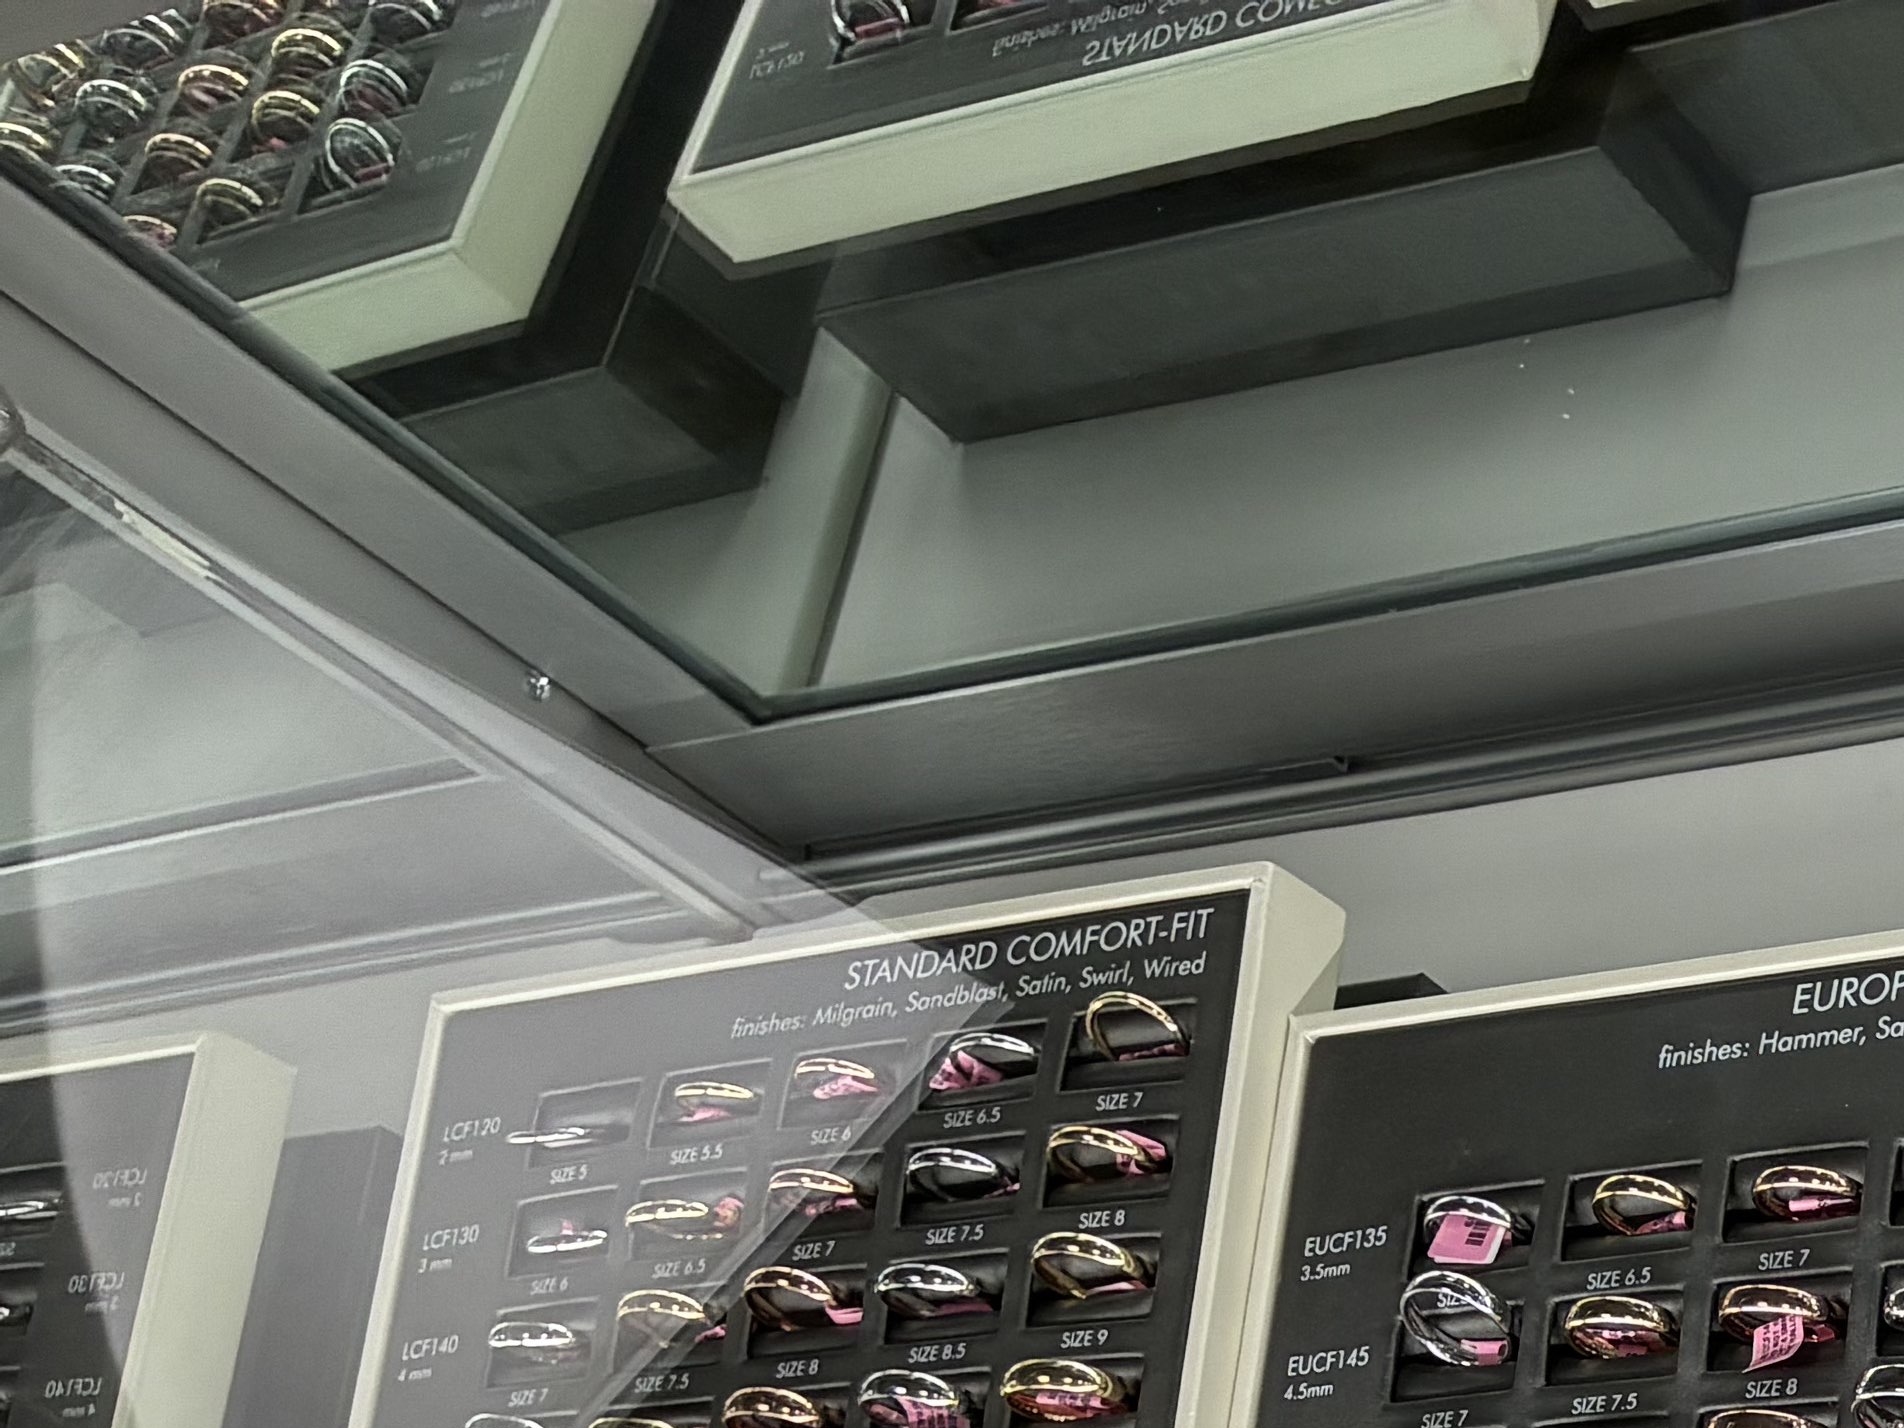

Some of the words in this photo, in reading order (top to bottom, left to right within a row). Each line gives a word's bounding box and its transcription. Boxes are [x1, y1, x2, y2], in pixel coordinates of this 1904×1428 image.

[844, 940, 997, 990] STANDARD
[1006, 908, 1214, 967] COMFORT-FIT
[730, 1012, 805, 1039] finishes:
[811, 996, 898, 1028] Milgrain,
[904, 982, 1007, 1013] Sandblast,
[1015, 971, 1072, 997] Satin,
[1078, 960, 1134, 989] Swirl,
[1143, 950, 1207, 979] Wired
[1658, 1038, 1750, 1069] finishes:
[1758, 1026, 1866, 1055] Hammer,
[1095, 1092, 1129, 1112] SIZE
[1132, 1091, 1144, 1108] 7
[442, 1116, 502, 1143] LCF120
[422, 1224, 480, 1251] LCF130
[1304, 1225, 1388, 1257] EUCF135
[1300, 1263, 1351, 1282] 3.5mm
[401, 1334, 459, 1361] LCF140
[1060, 1329, 1094, 1349] SIZE
[1096, 1329, 1109, 1346] 9
[1287, 1345, 1370, 1377] EUCF145
[1283, 1382, 1334, 1400] 4.5mm
